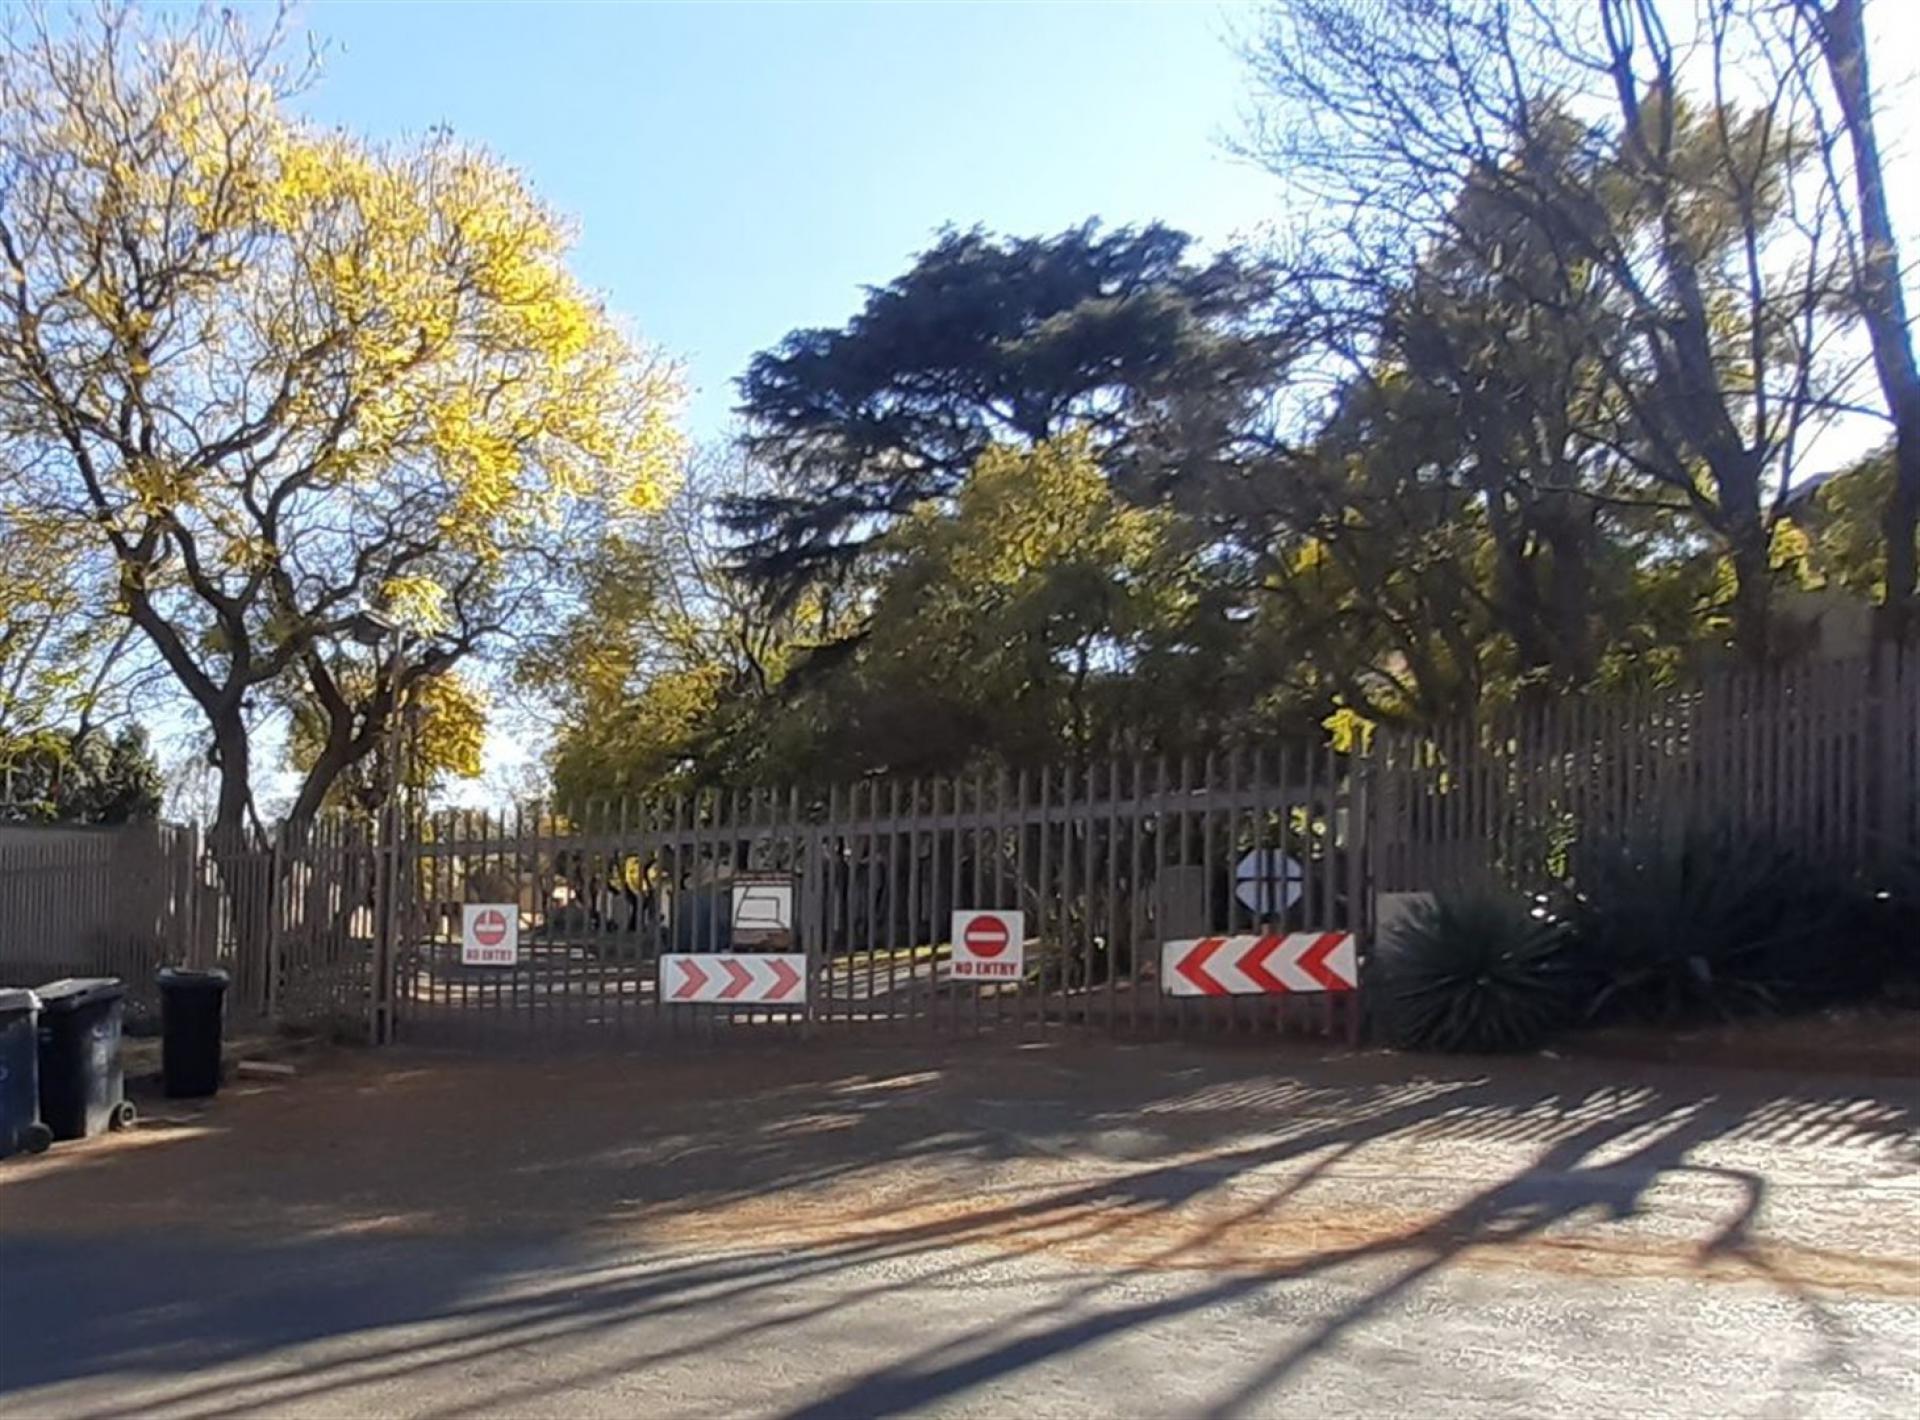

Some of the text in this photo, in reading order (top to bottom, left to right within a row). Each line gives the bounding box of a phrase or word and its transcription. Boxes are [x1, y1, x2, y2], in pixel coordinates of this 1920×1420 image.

[466, 949, 512, 961] NO ENTRY
[955, 962, 1017, 976] NO ENTRY
